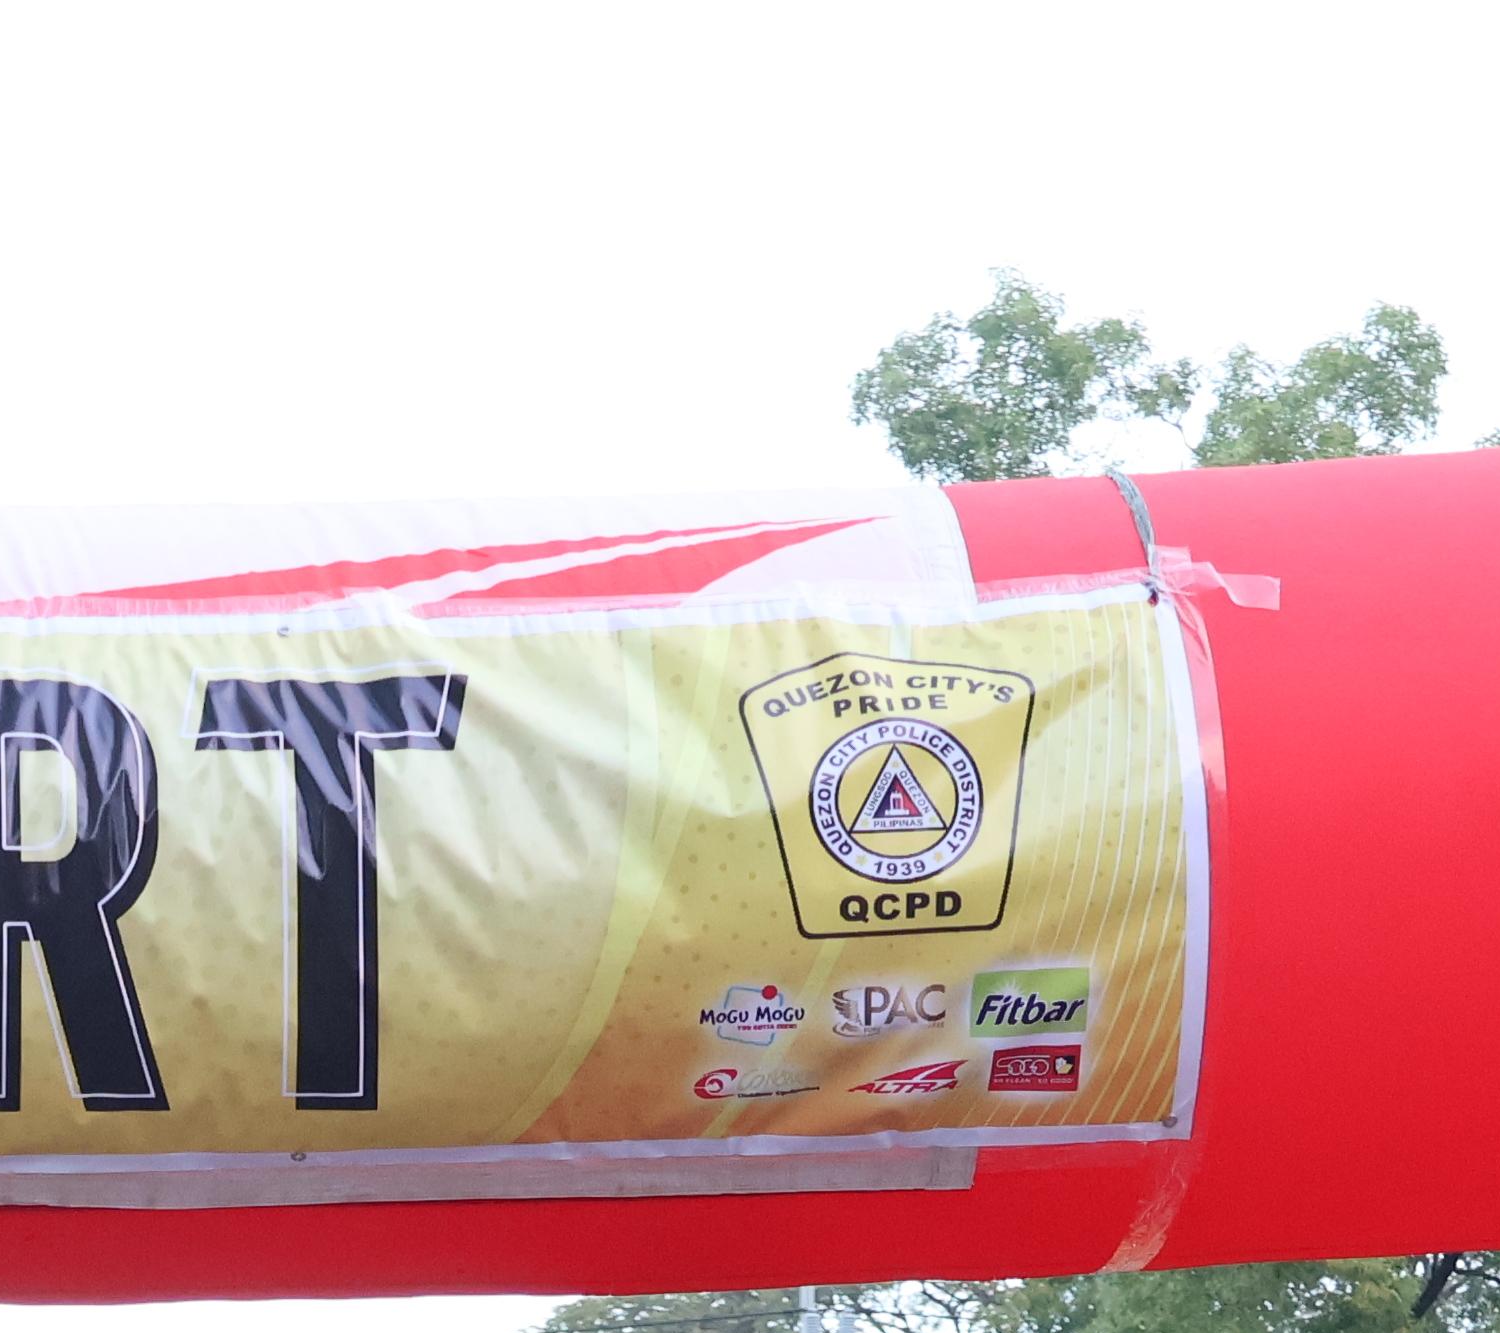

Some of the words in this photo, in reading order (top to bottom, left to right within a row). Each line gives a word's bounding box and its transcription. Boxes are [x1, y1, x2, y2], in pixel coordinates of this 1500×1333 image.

[764, 669, 894, 718] QUEZON
[906, 674, 1015, 703] CITY'S
[833, 692, 949, 718] PRIDE
[829, 732, 870, 767] CITY
[878, 724, 955, 759] POLICE
[863, 771, 893, 817] LUNGSOD
[898, 769, 931, 815] QUEZON
[946, 759, 976, 853] DISTRICT
[817, 772, 853, 857] QUEZON
[873, 818, 924, 829] PILIPINAS
[873, 859, 926, 876] 1939
[839, 889, 963, 924] QCPD
[975, 992, 1085, 1027] Fitbar
[849, 1079, 958, 1095] ALTRA
